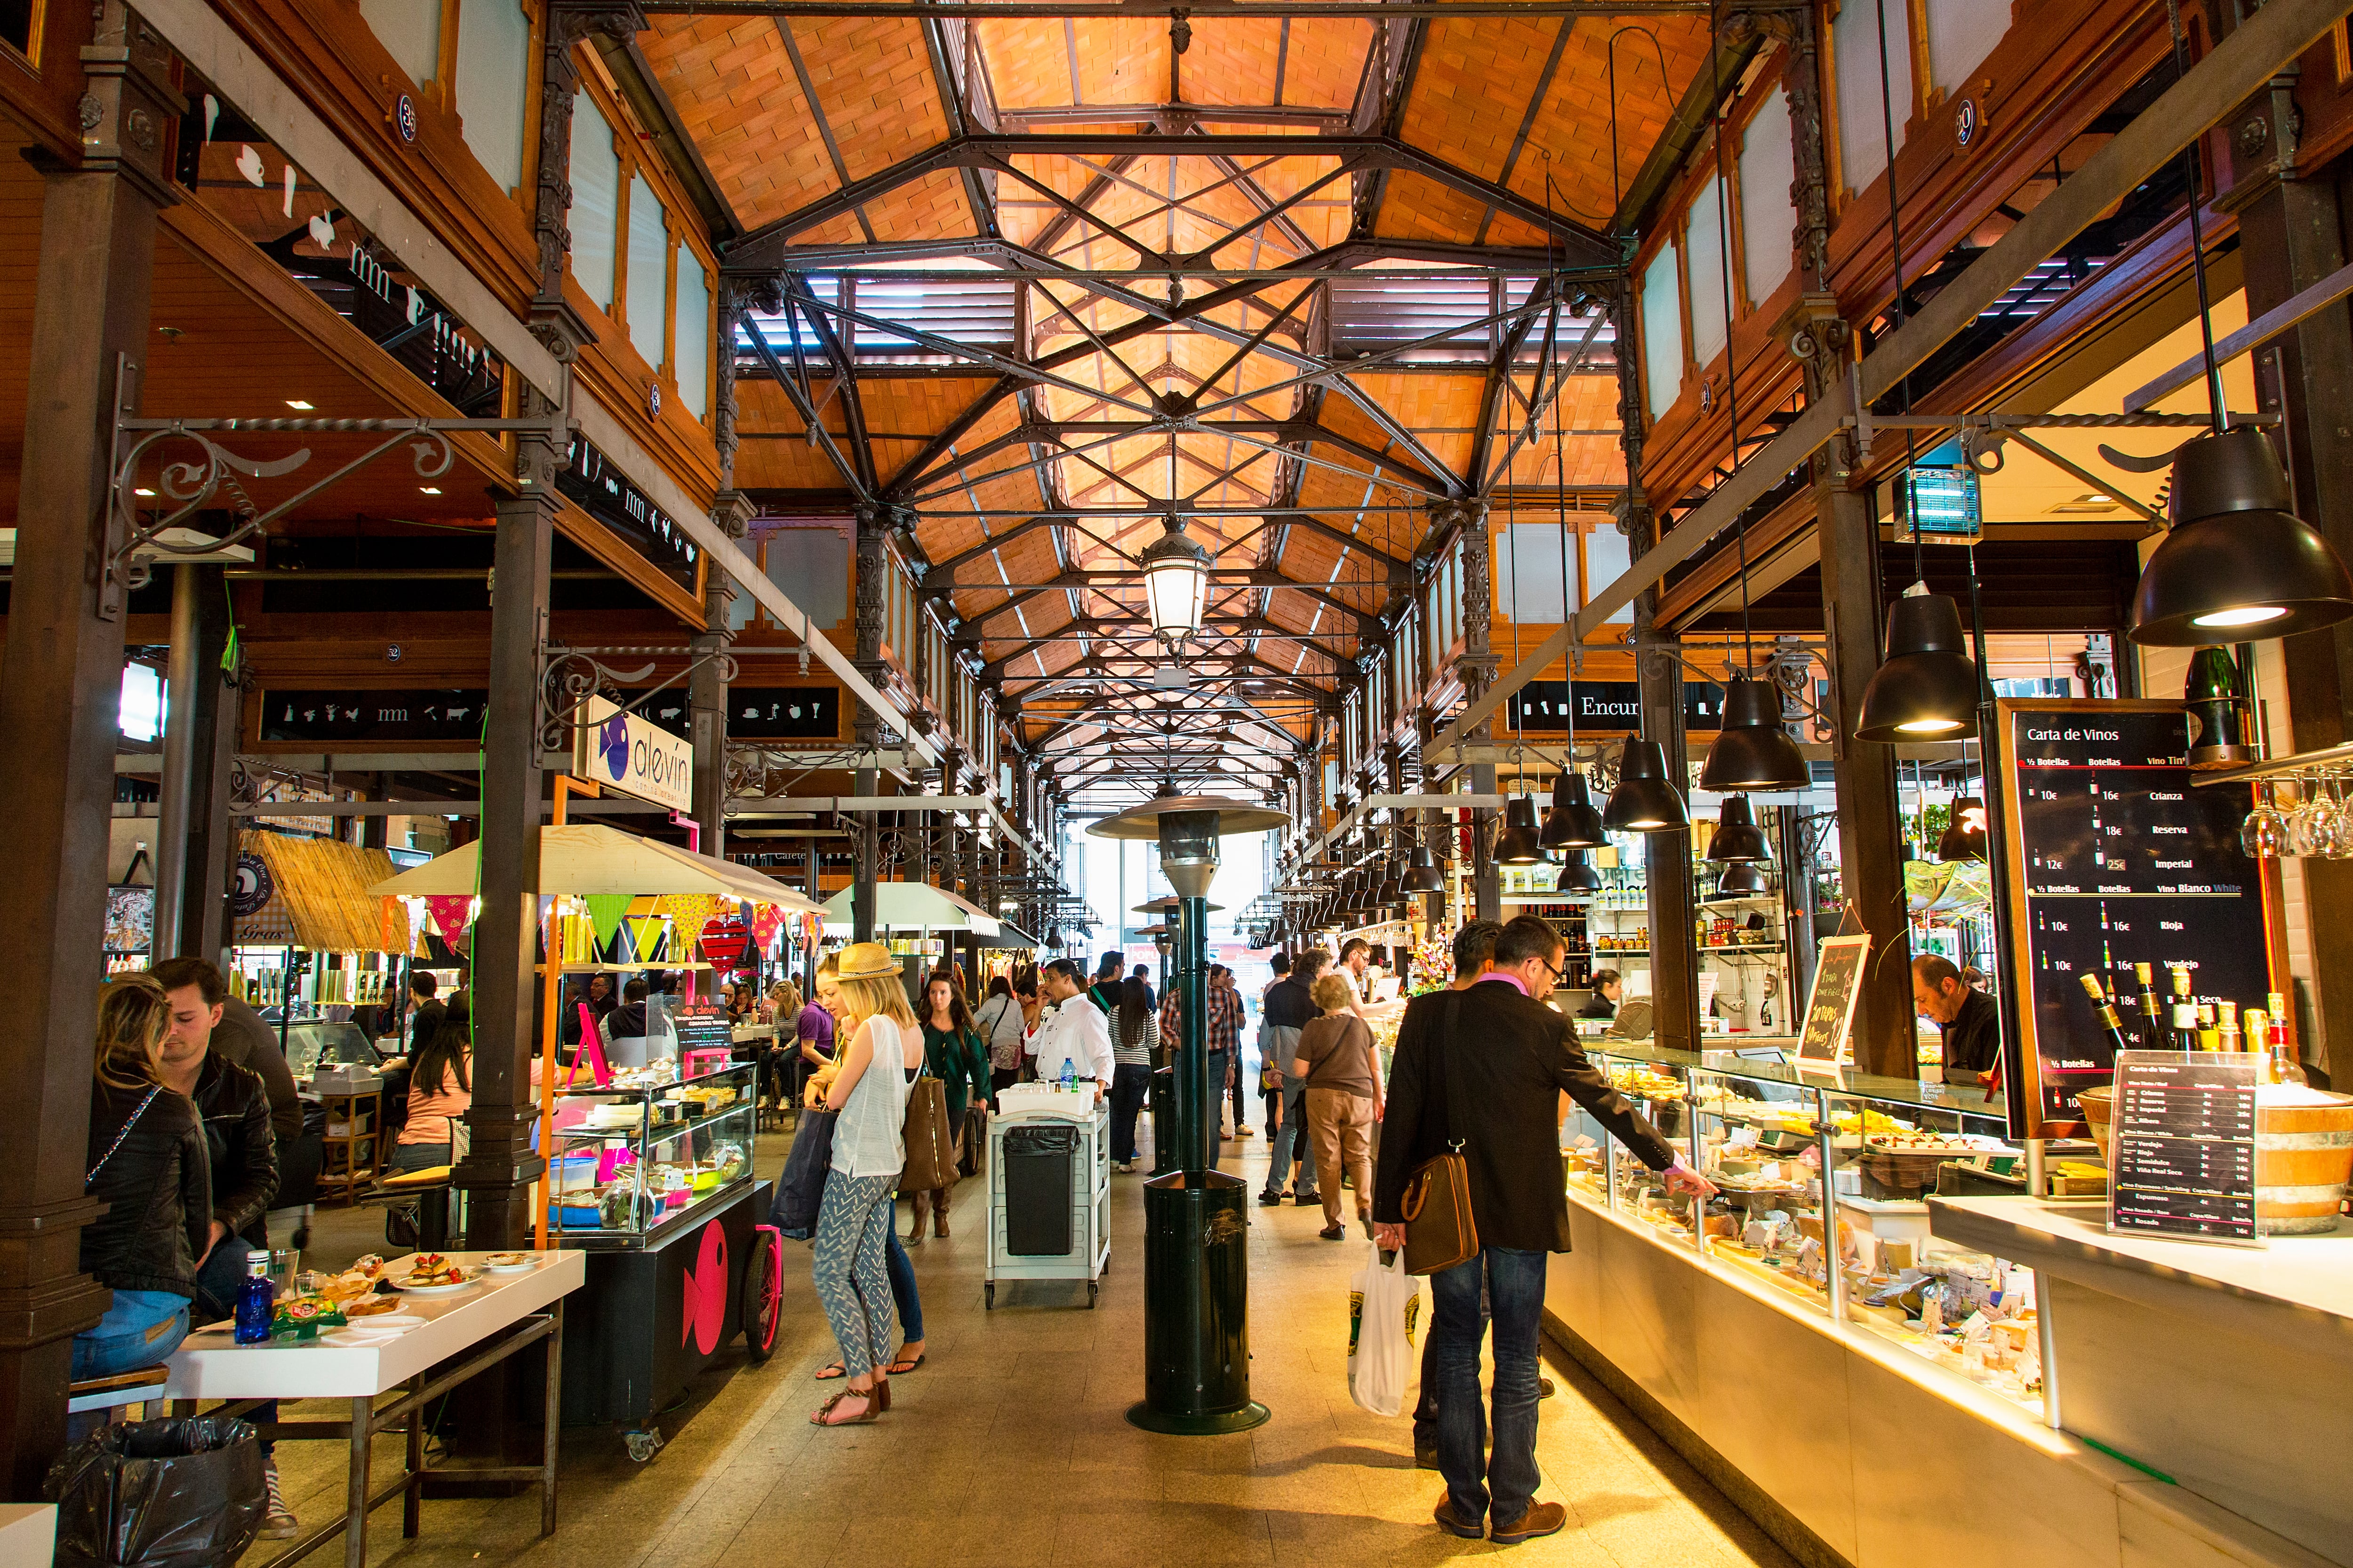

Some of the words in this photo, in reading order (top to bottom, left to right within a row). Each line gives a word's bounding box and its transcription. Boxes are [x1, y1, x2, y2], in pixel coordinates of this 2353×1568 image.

[403, 104, 416, 132] 35
[1957, 107, 1971, 136] 20
[388, 648, 399, 658] 52
[2027, 728, 2061, 741] Carta
[2064, 728, 2081, 740] de
[2083, 729, 2119, 741] Vinos
[635, 731, 687, 794] alevín
[2167, 757, 2185, 765] Tin
[636, 781, 657, 795] cocina
[661, 791, 686, 806] creativa
[2041, 791, 2057, 800] 10€
[2103, 791, 2119, 800] 16€
[2105, 826, 2122, 836] 18€
[2046, 860, 2063, 869] 12€
[2108, 860, 2125, 869] 25€
[2155, 860, 2193, 870] Imperial
[2047, 885, 2080, 893] Botellas
[2177, 884, 2211, 893] Blanco
[2213, 884, 2241, 893] White
[2051, 921, 2068, 931] 10€
[2113, 921, 2130, 931] 16€
[2160, 921, 2184, 931] Rioja
[239, 923, 284, 940] Gras
[1132, 951, 1158, 960] POPU
[2055, 960, 2072, 970] 10€
[2116, 960, 2134, 970] 16€
[2163, 960, 2200, 970] Verdejo
[2119, 996, 2137, 1005] 18€
[2200, 995, 2222, 1004] Seco
[2126, 1033, 2140, 1042] 4€
[2062, 1060, 2095, 1068] Botellas
[2135, 1193, 2169, 1201] Espumoso
